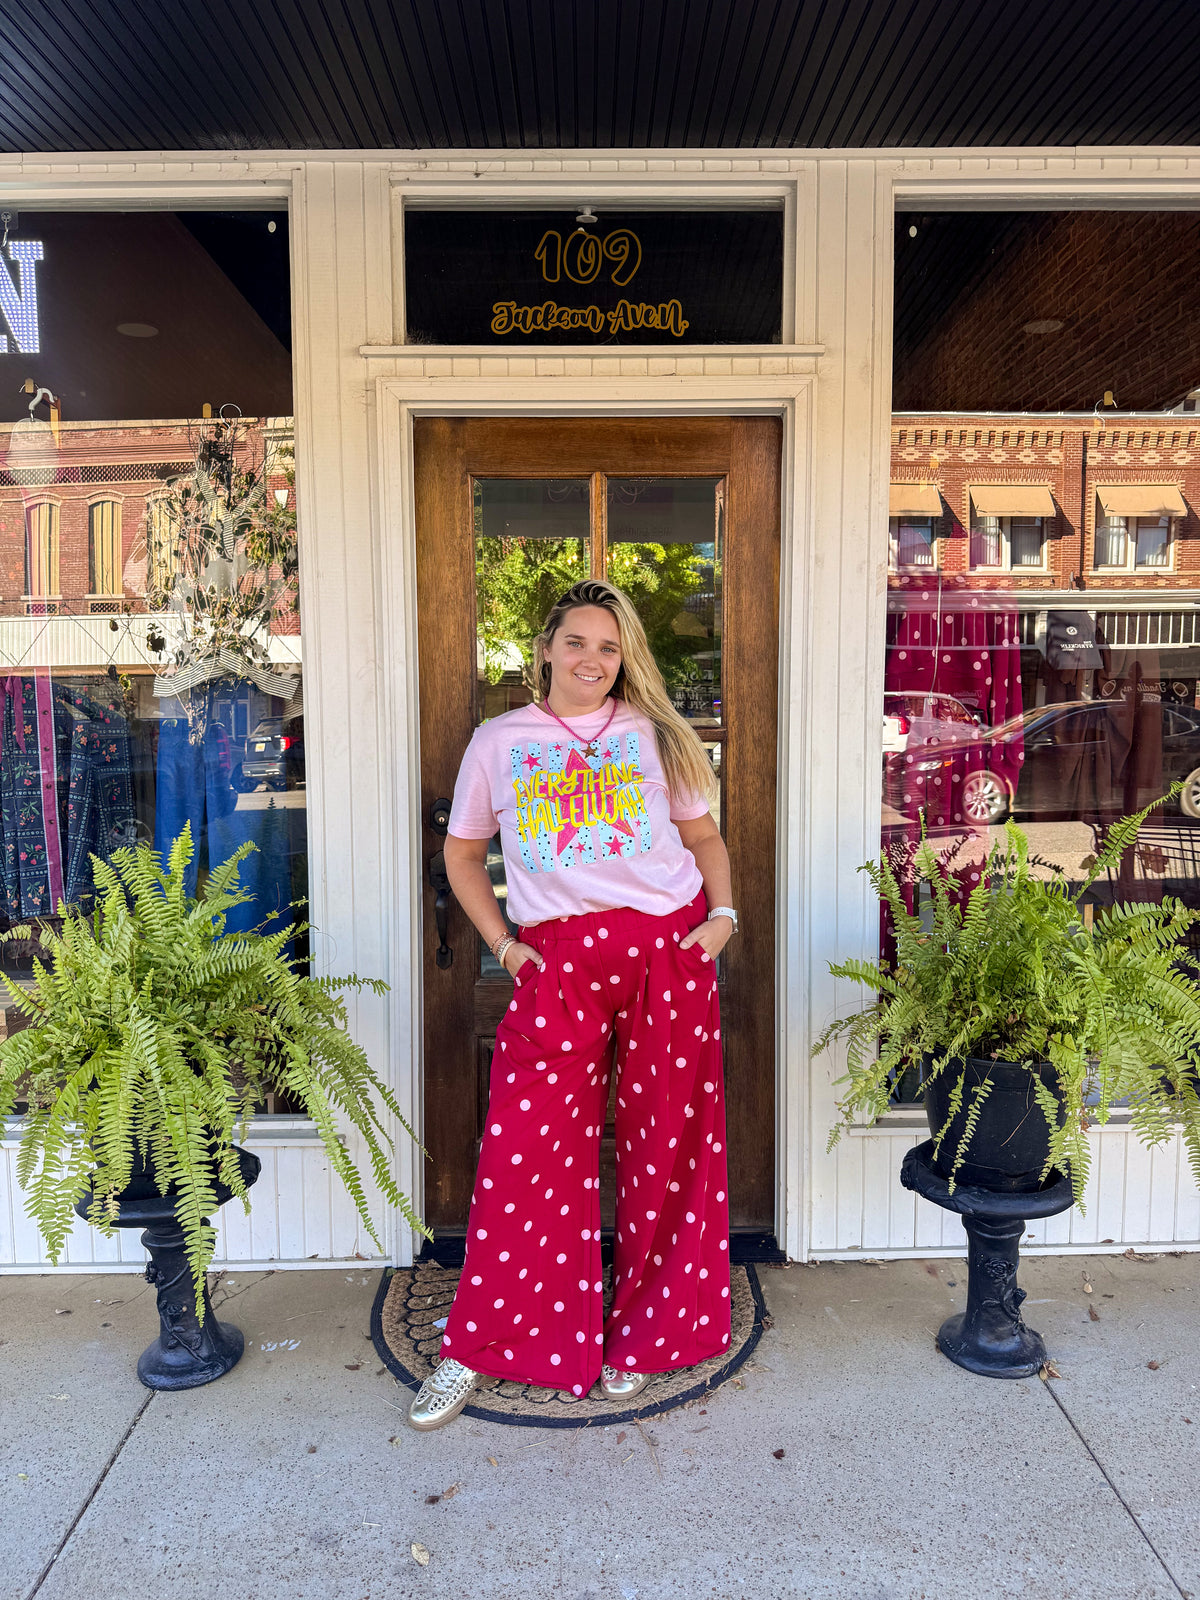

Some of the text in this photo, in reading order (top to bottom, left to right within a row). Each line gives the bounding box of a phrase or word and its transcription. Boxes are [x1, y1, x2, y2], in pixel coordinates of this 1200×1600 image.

[534, 229, 642, 286] 109
[490, 300, 604, 335] Jackson
[512, 762, 644, 808] EVERYTHING
[516, 786, 647, 842] HALLELUJAH
